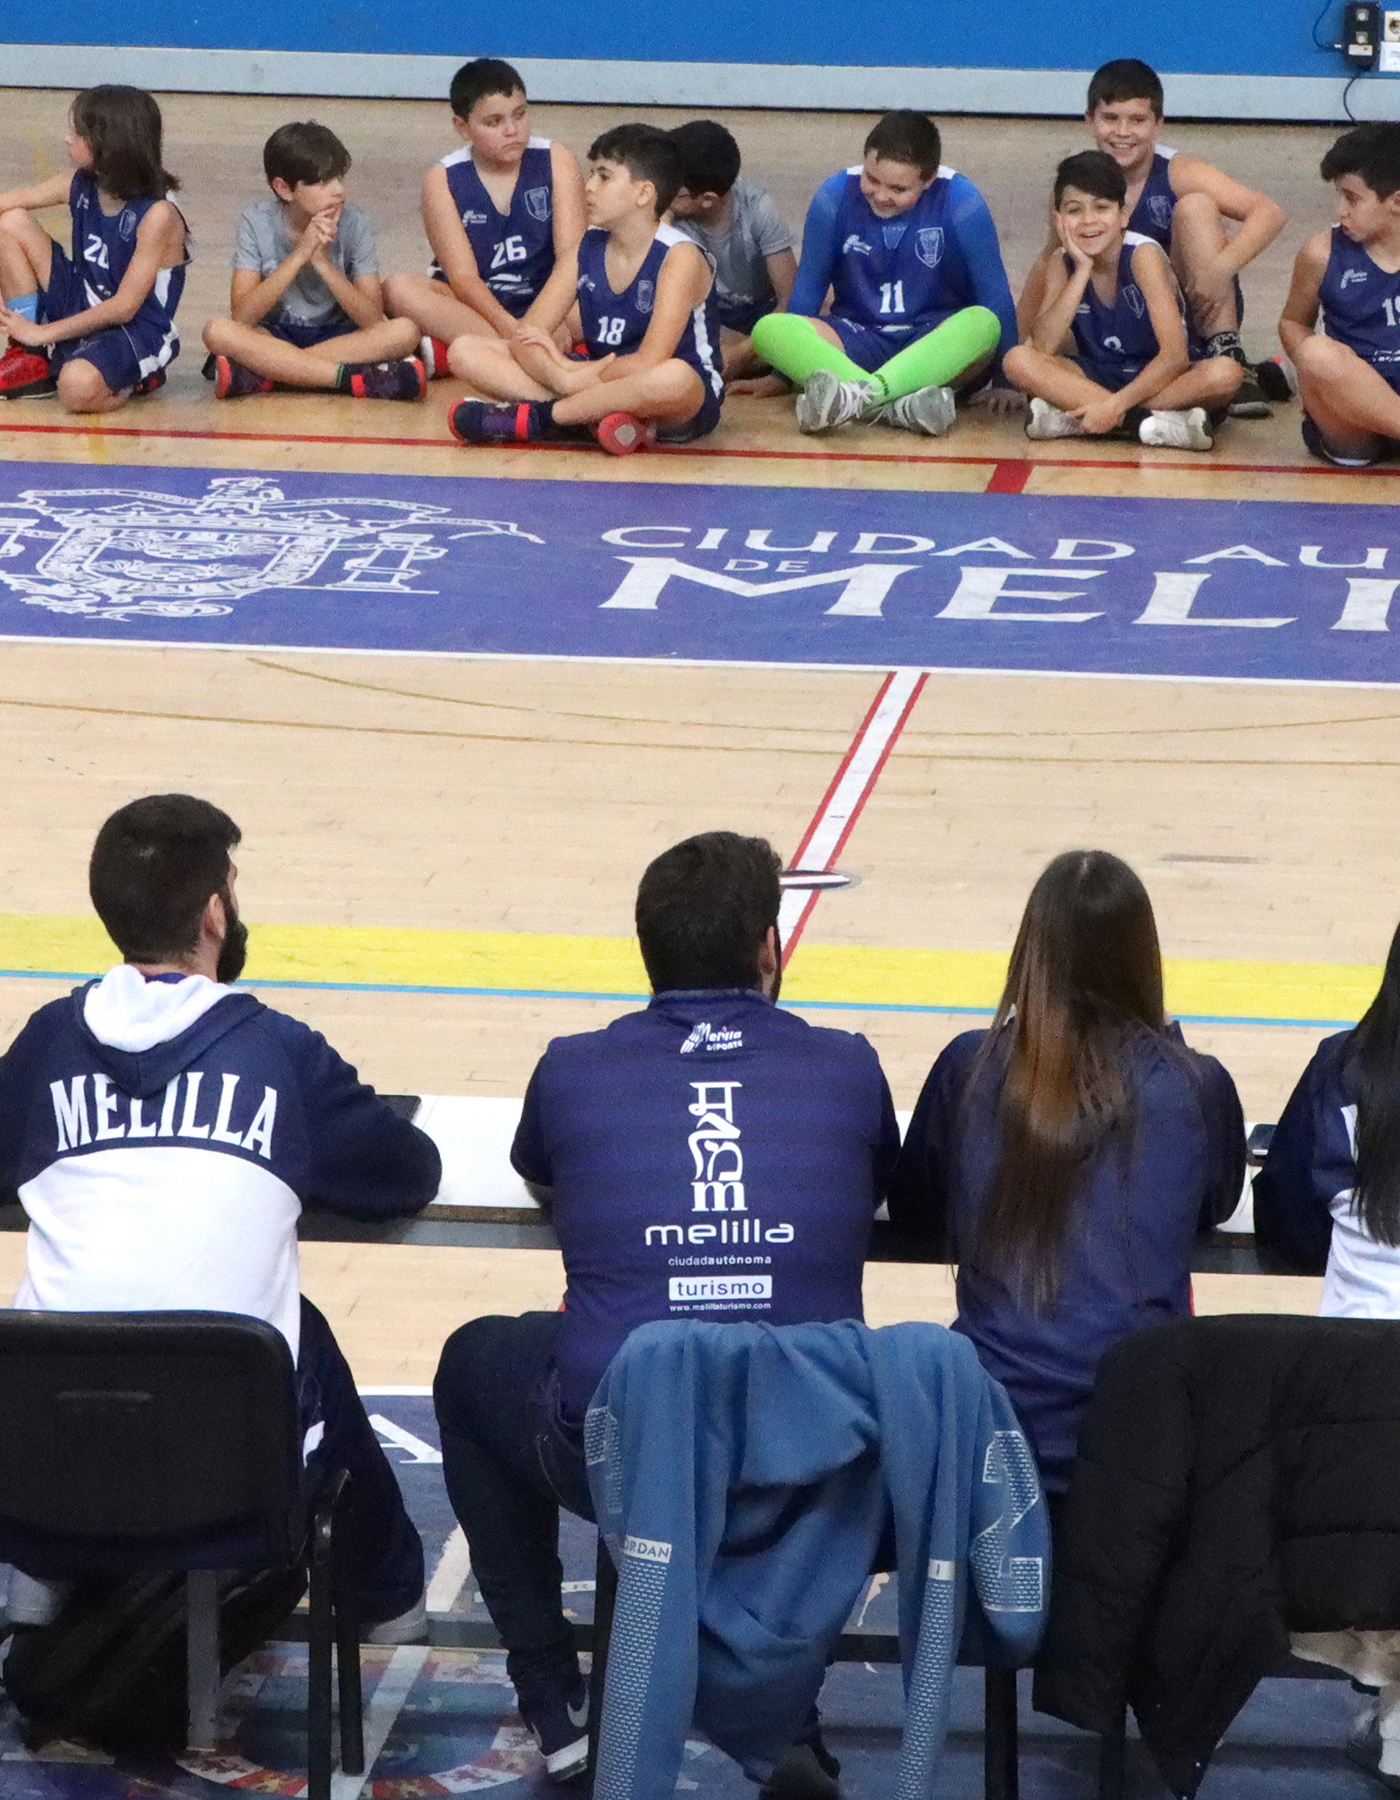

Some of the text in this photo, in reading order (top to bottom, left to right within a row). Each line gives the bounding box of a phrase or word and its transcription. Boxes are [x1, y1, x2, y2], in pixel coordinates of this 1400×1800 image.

[491, 235, 527, 269] 26
[879, 280, 906, 313] 11
[597, 315, 626, 346] 18
[601, 525, 1136, 562] CIUDAD
[724, 558, 809, 574] DE
[50, 1071, 277, 1160] MELILLA
[645, 1218, 794, 1246] melilla
[668, 1254, 772, 1266] ciudadautónoma
[677, 1280, 765, 1297] turismo
[669, 1303, 771, 1312] www.melillaturismo.com
[624, 1540, 670, 1560] RDAN
